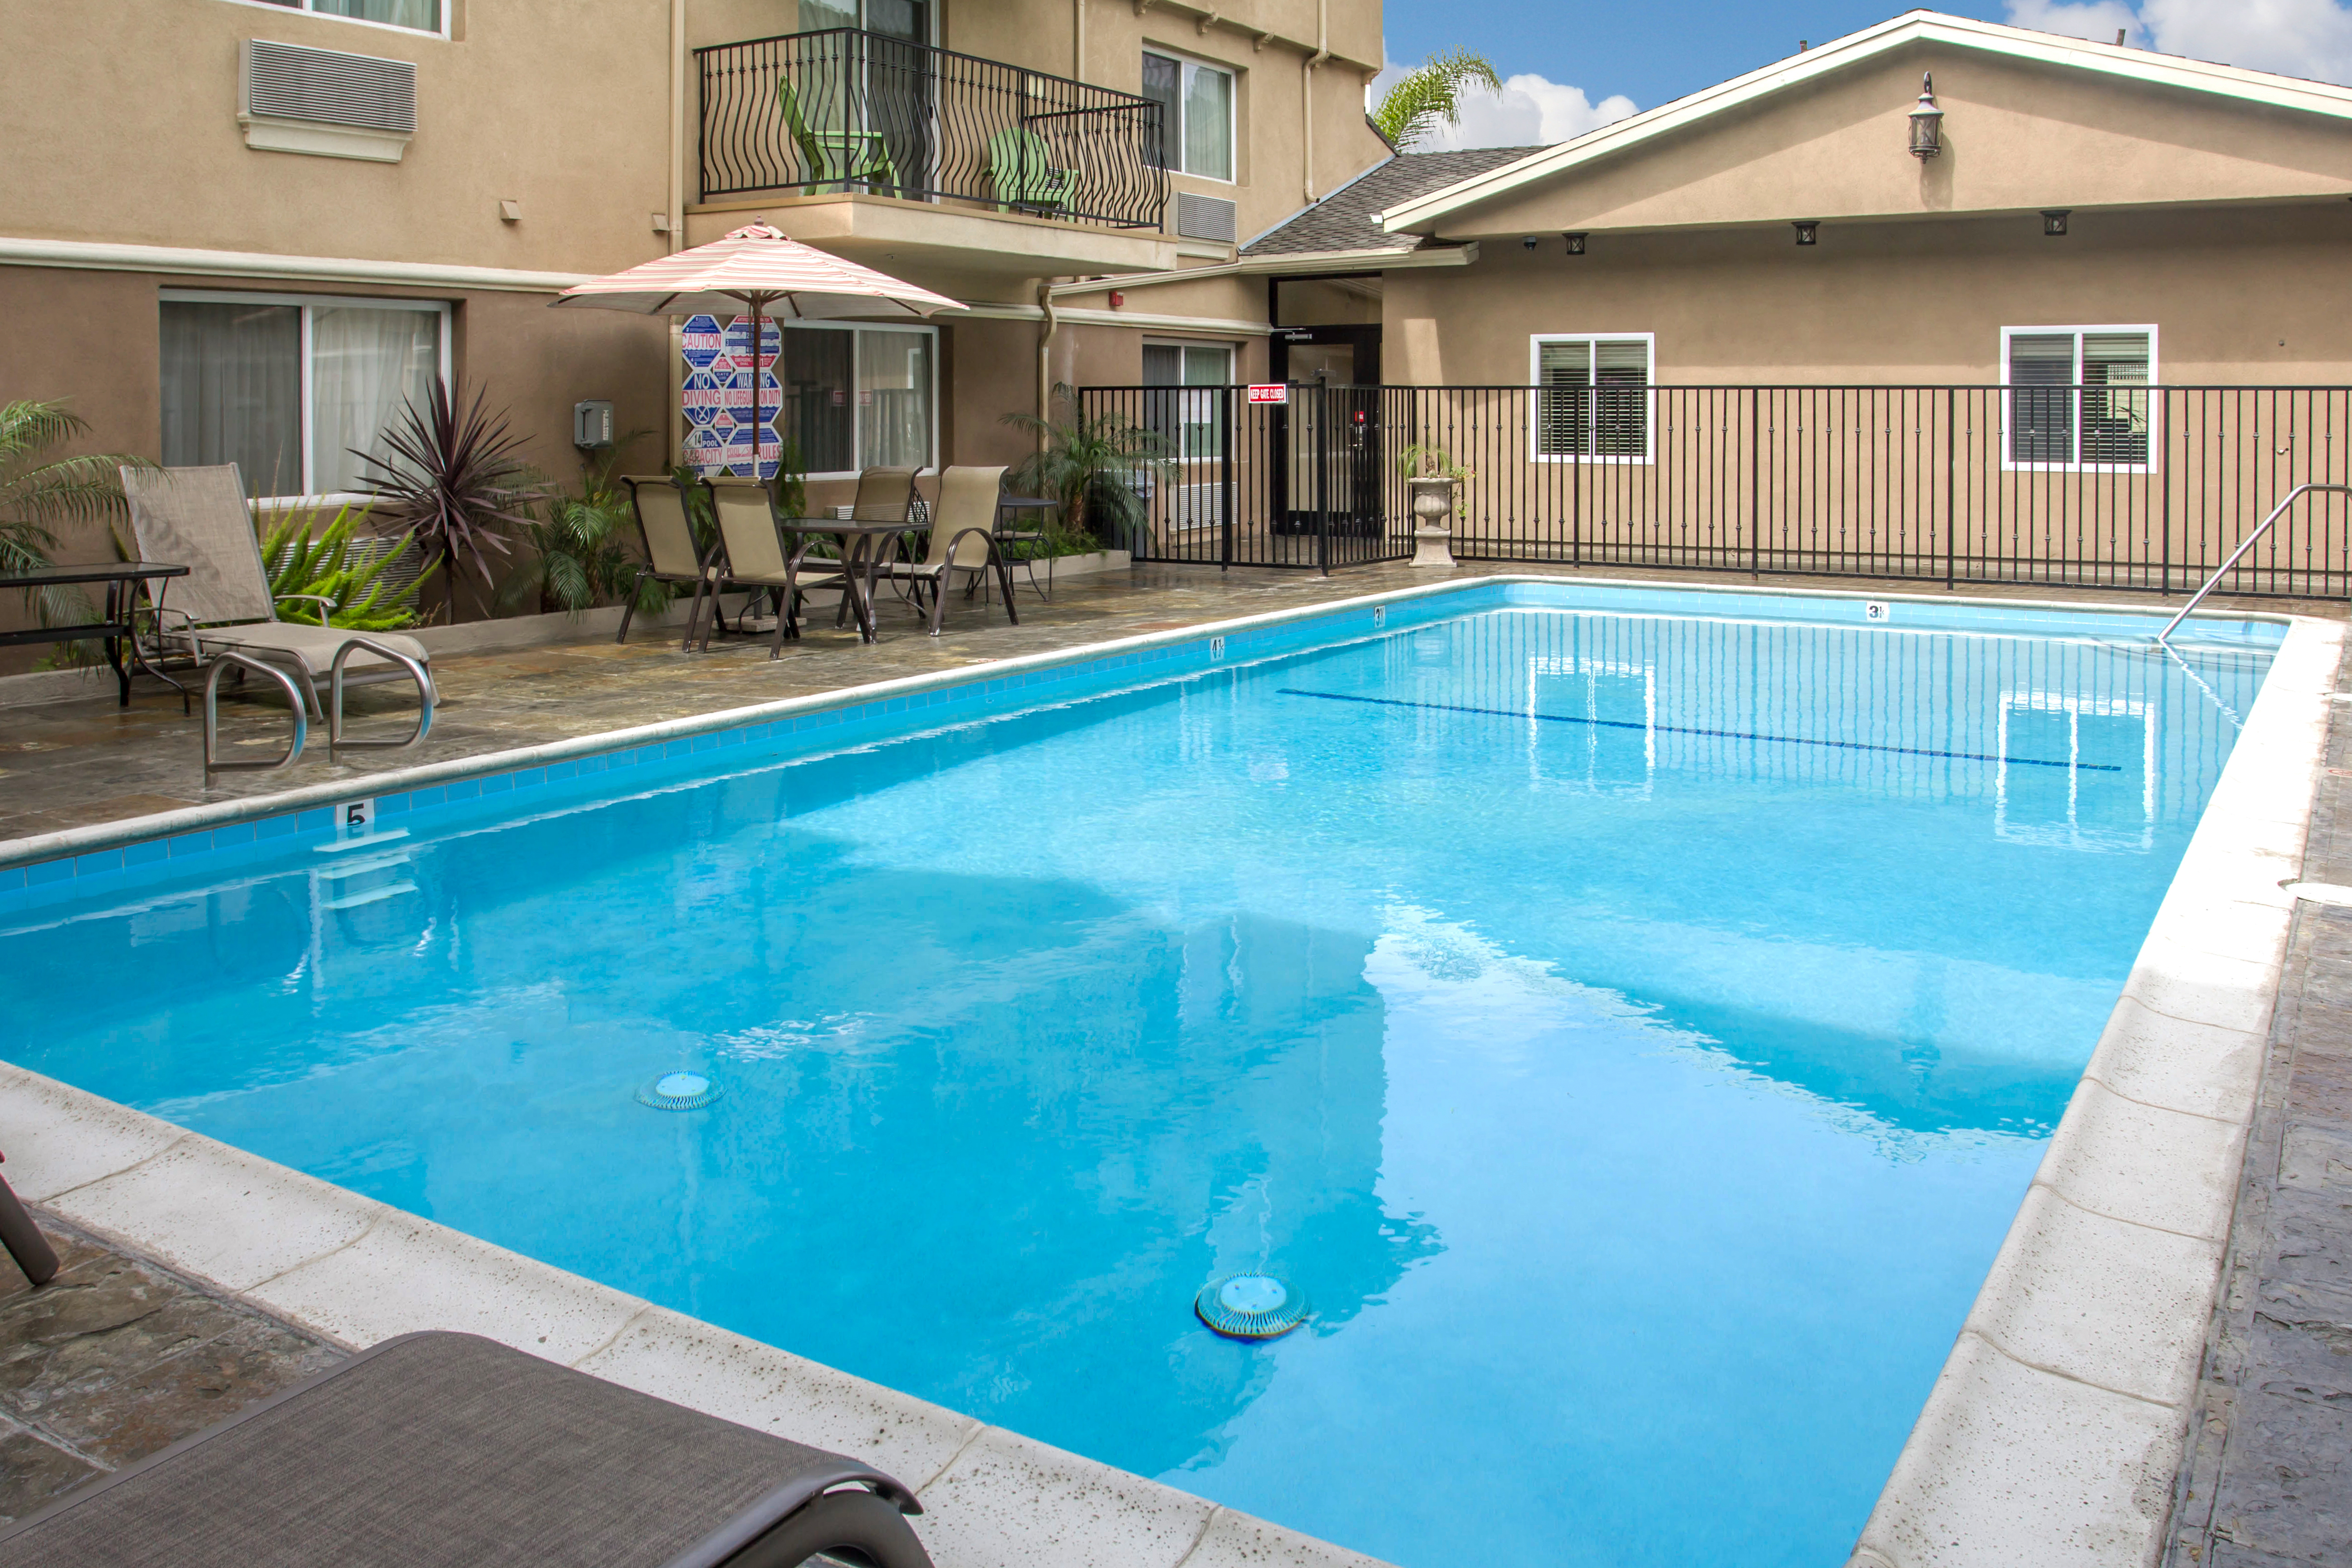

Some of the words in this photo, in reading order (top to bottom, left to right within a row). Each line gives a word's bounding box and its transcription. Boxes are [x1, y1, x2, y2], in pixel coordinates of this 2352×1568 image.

[682, 334, 721, 348] CAUTION
[694, 373, 710, 390] NO
[737, 373, 770, 388] WARNG
[682, 390, 721, 406] DIVING
[725, 391, 732, 405] NO
[733, 391, 753, 405] LIFEGUA
[760, 390, 767, 404] ON
[769, 390, 781, 404] DUTY
[1250, 389, 1259, 399] KEEP
[1260, 388, 1269, 399] GATE
[1270, 388, 1284, 399] CLOSED
[695, 434, 701, 446] 14
[682, 448, 723, 465] CAPACITY
[347, 803, 365, 826] 5
